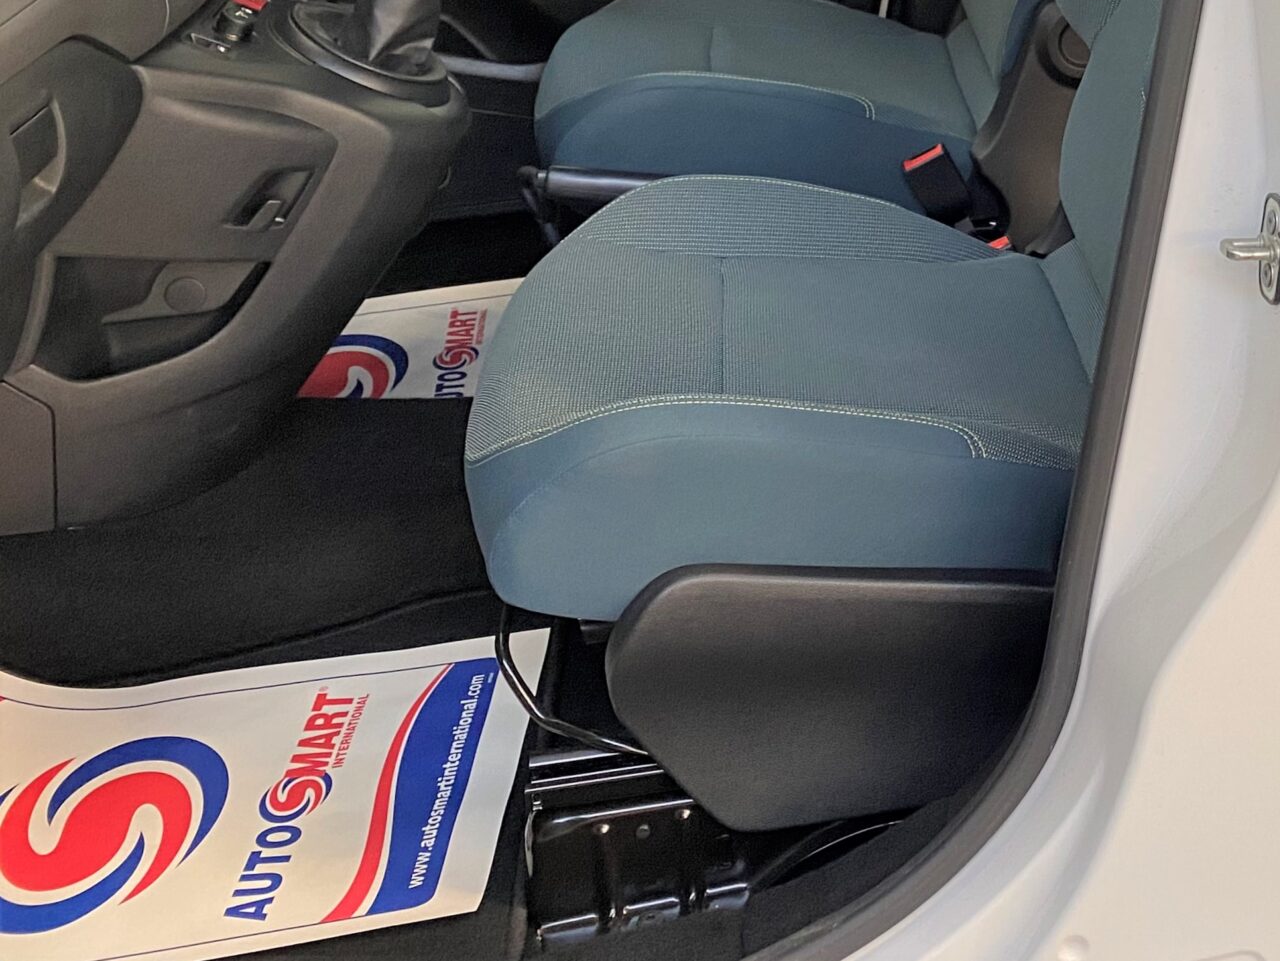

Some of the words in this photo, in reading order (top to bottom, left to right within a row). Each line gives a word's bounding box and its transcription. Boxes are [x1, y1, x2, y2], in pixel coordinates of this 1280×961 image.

[432, 309, 479, 398] UTOSMART
[332, 693, 370, 769] INTERNATIONAL
[408, 674, 485, 889] www.autosmartinternational.com
